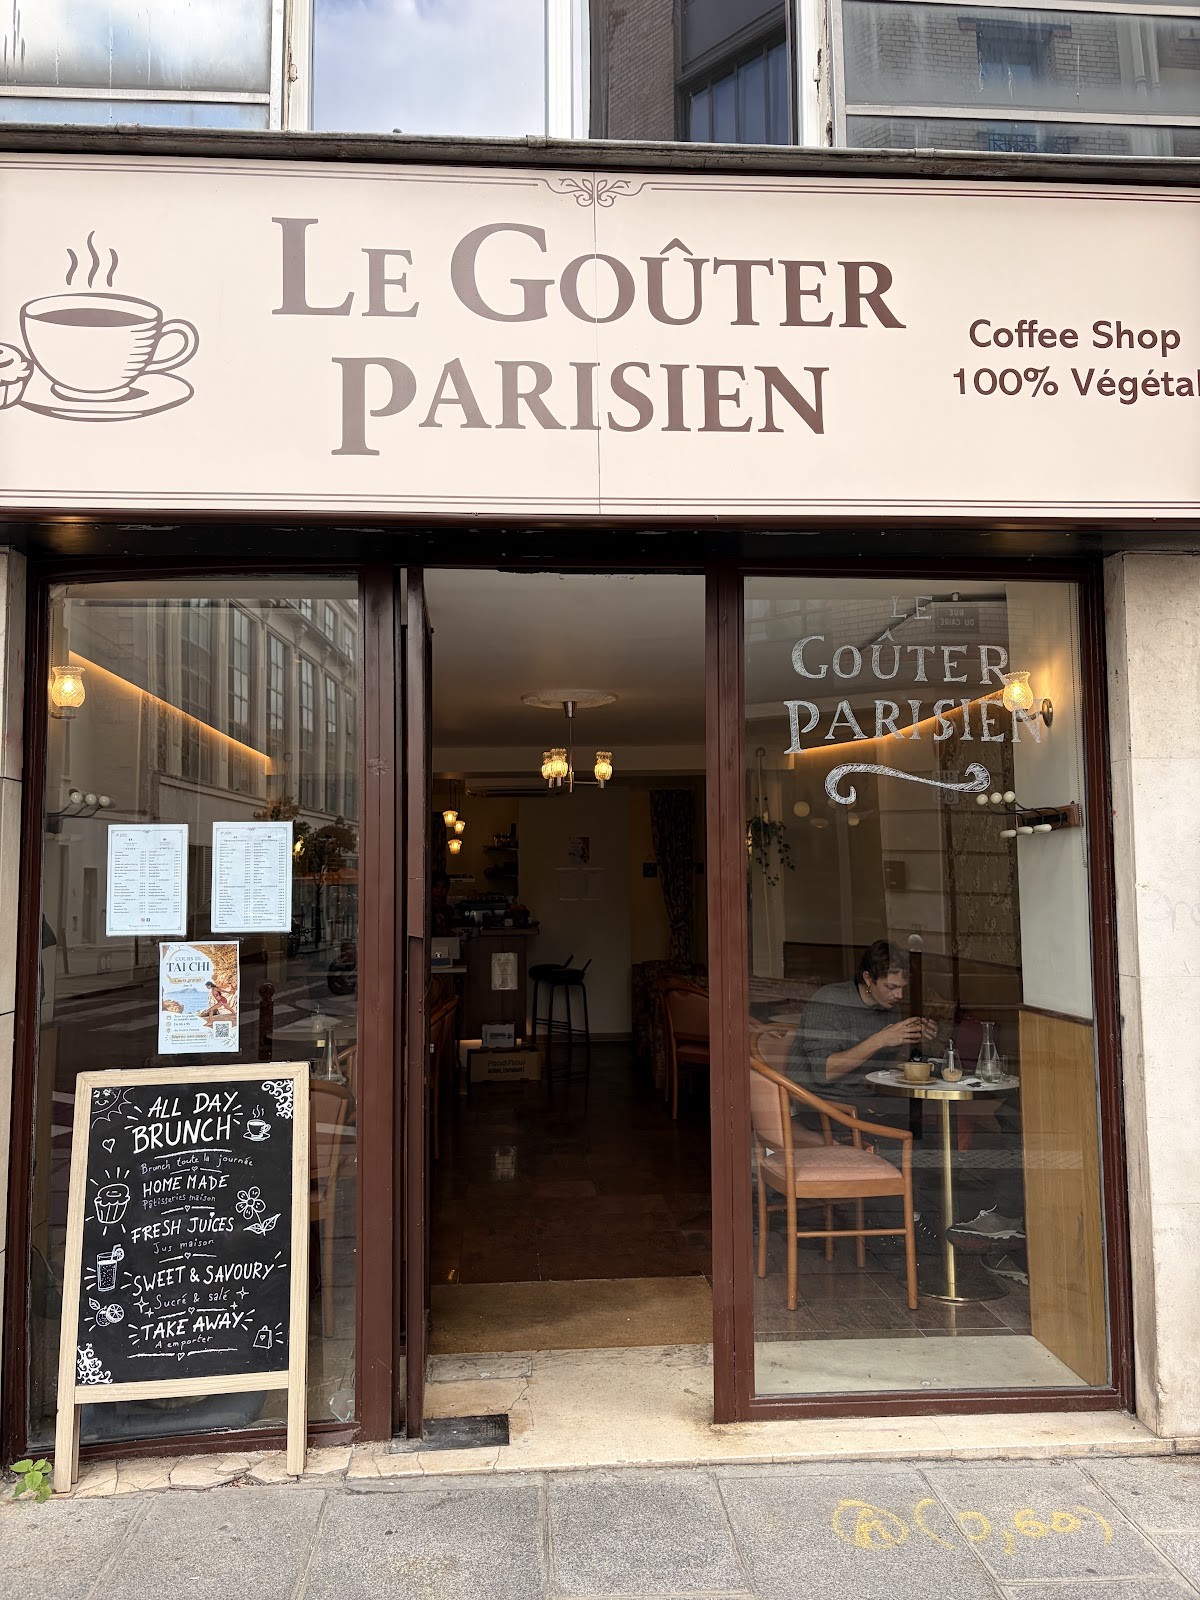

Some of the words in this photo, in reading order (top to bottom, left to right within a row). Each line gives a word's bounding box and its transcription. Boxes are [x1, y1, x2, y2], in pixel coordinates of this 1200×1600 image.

[271, 216, 421, 318] LE
[450, 222, 907, 330] GOÛTER
[969, 318, 1079, 348] Coffee
[1092, 319, 1181, 358] Shop
[952, 365, 1059, 398] 100%
[331, 356, 830, 456] PARISIEN
[890, 595, 933, 620] LE
[791, 627, 1011, 685] GOÛTER
[783, 699, 1045, 755] PARISIEN
[166, 962, 186, 973] TAI
[188, 961, 210, 972] CHI
[147, 1096, 182, 1119] ALL
[192, 1091, 239, 1114] DAY
[131, 1113, 232, 1154] BRUNCH
[140, 1160, 171, 1175] Brunch
[176, 1154, 200, 1167] toute
[203, 1153, 210, 1162] la
[215, 1154, 254, 1168] journée
[142, 1176, 183, 1198] HOME
[186, 1174, 230, 1191] MADE
[189, 1193, 216, 1202] maison
[130, 1218, 182, 1244] FRESH
[152, 1241, 173, 1255] Jus
[179, 1238, 214, 1250] maison
[132, 1265, 187, 1297] SWEET
[189, 1267, 200, 1283] &
[202, 1261, 275, 1285] SAVOURY
[153, 1292, 188, 1310] Sucré
[193, 1292, 200, 1303] &
[208, 1286, 231, 1302] salé
[140, 1318, 189, 1341] TAKE
[192, 1311, 245, 1333] AWAY
[155, 1340, 162, 1349] A
[167, 1334, 214, 1351] emporter
